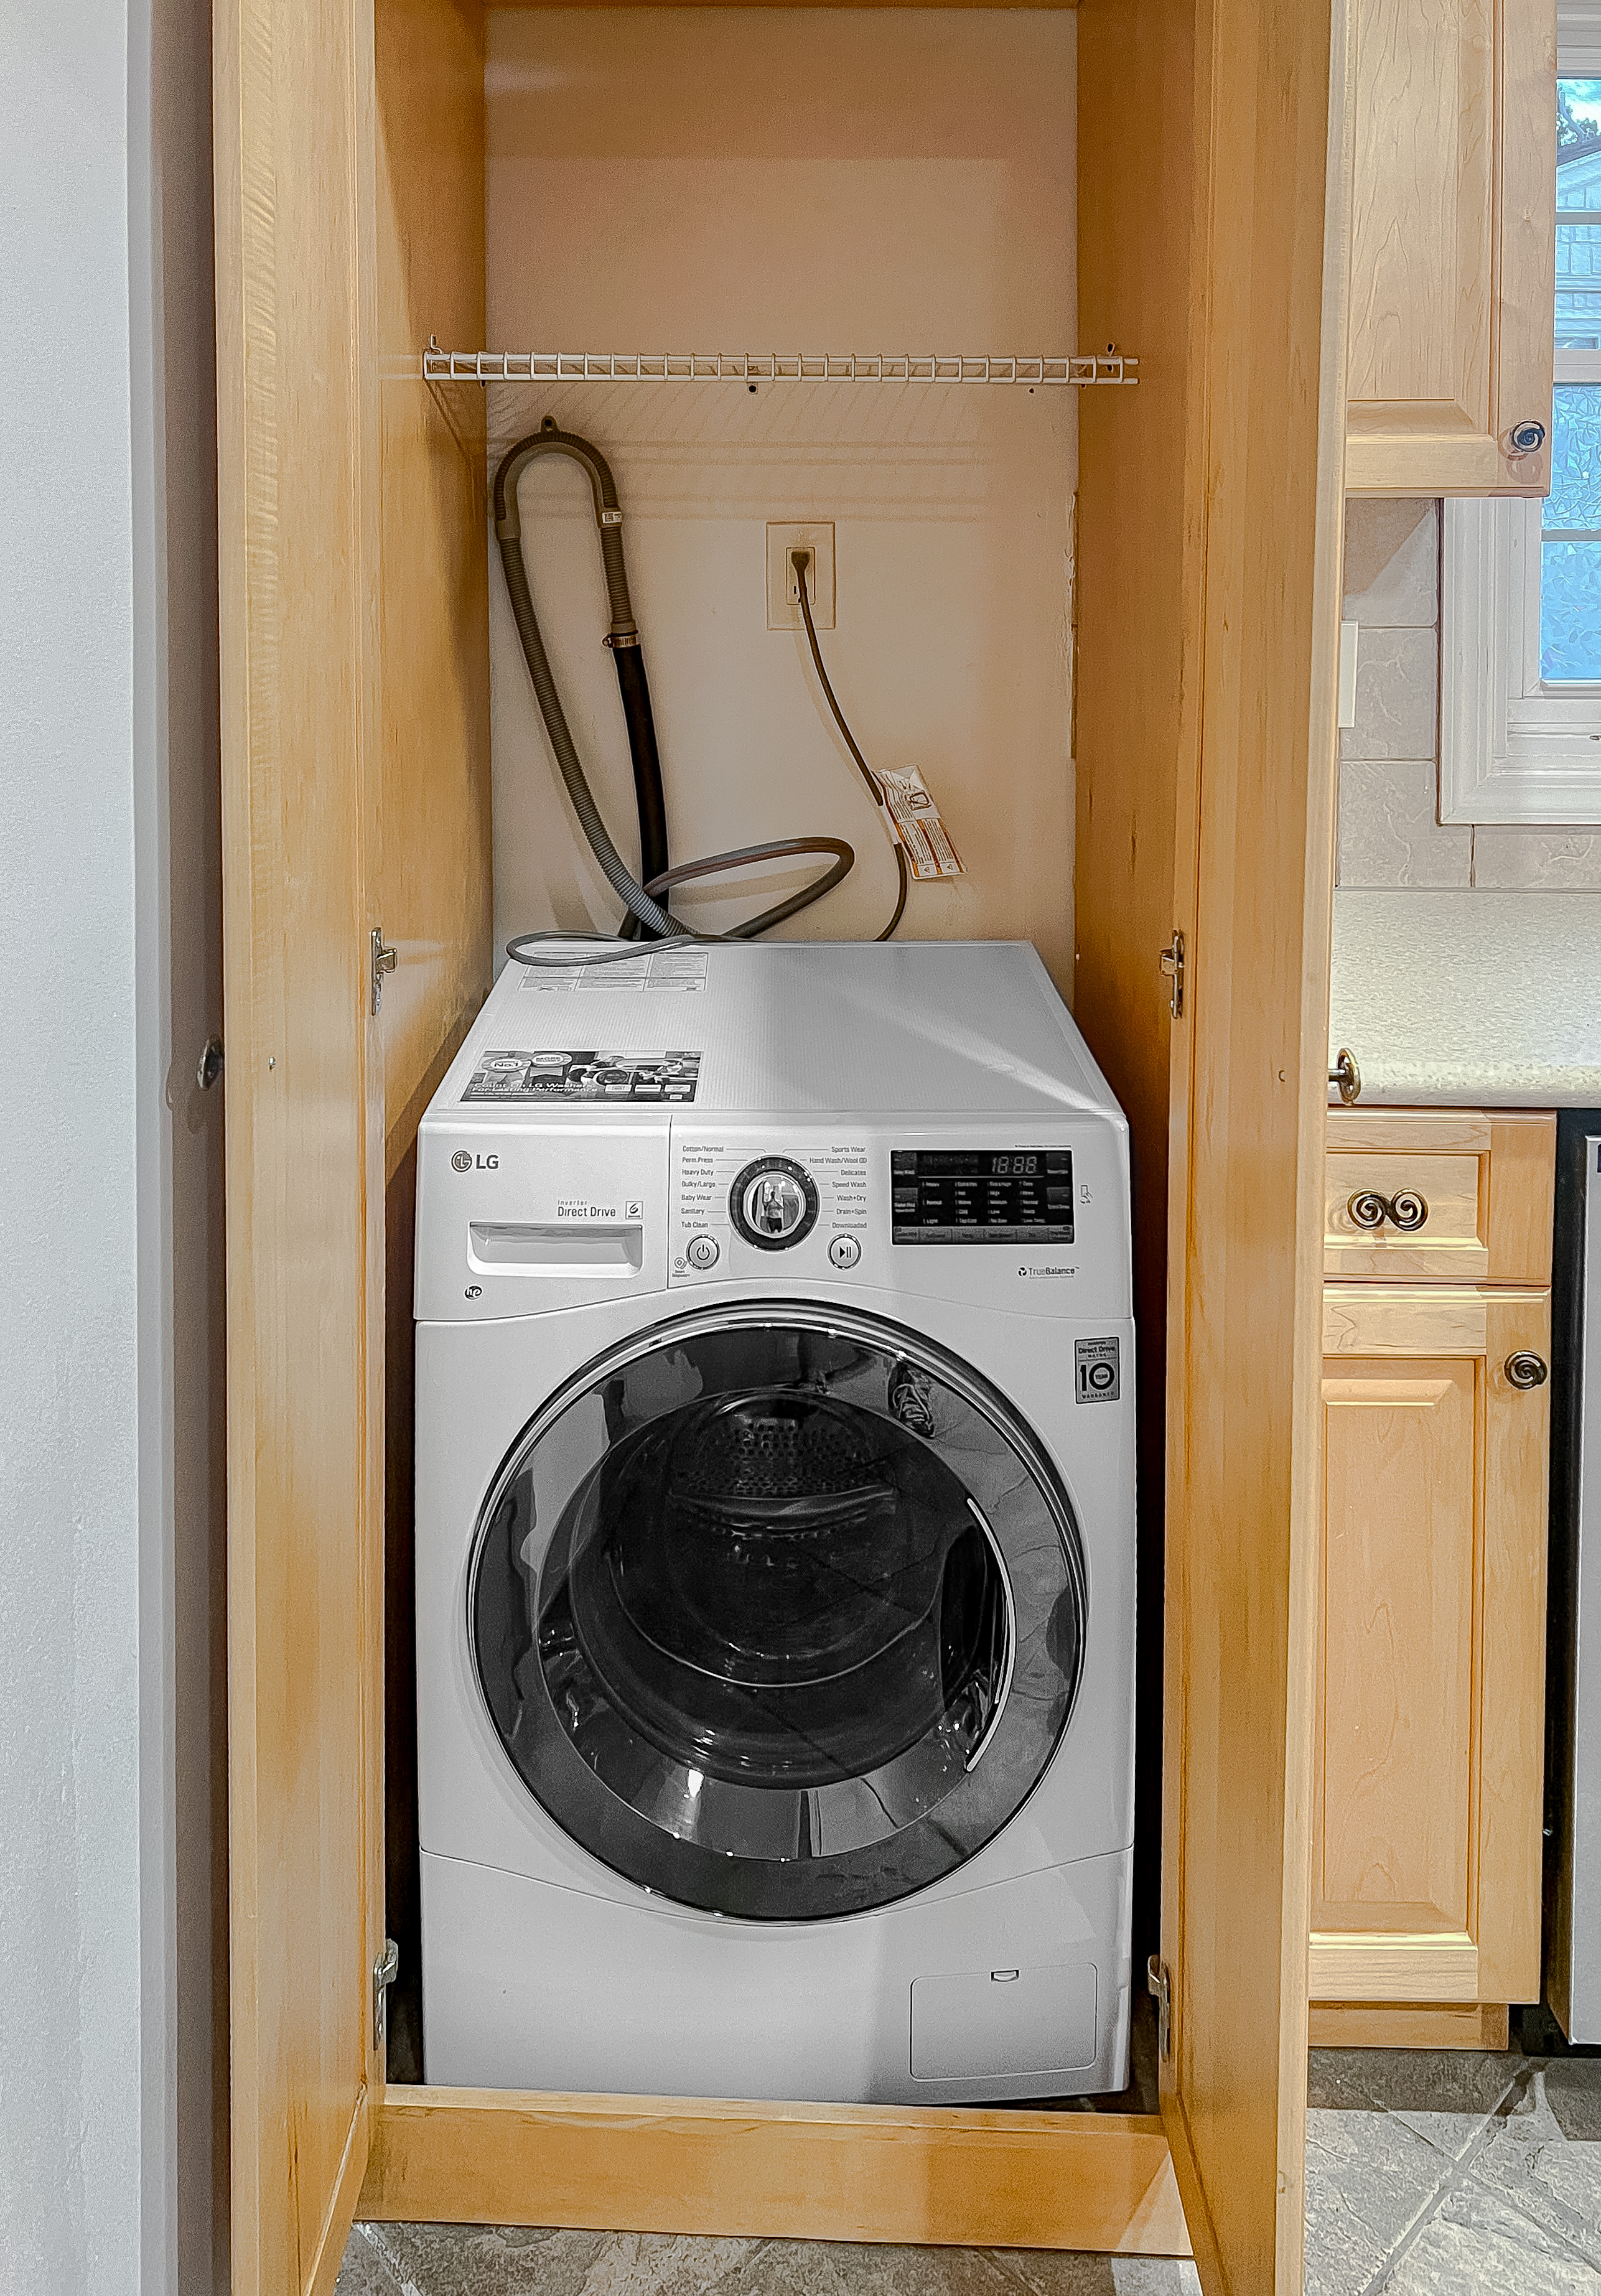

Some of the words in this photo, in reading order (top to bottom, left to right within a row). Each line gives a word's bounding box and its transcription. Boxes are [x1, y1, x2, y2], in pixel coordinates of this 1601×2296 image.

[475, 1154, 500, 1170] LG
[701, 1169, 714, 1177] Duty
[558, 1206, 587, 1217] Direct
[590, 1206, 616, 1217] Drive
[681, 1207, 705, 1216] Sanitary
[1029, 1267, 1075, 1276] TrueBalance
[1080, 1362, 1116, 1392] 10
